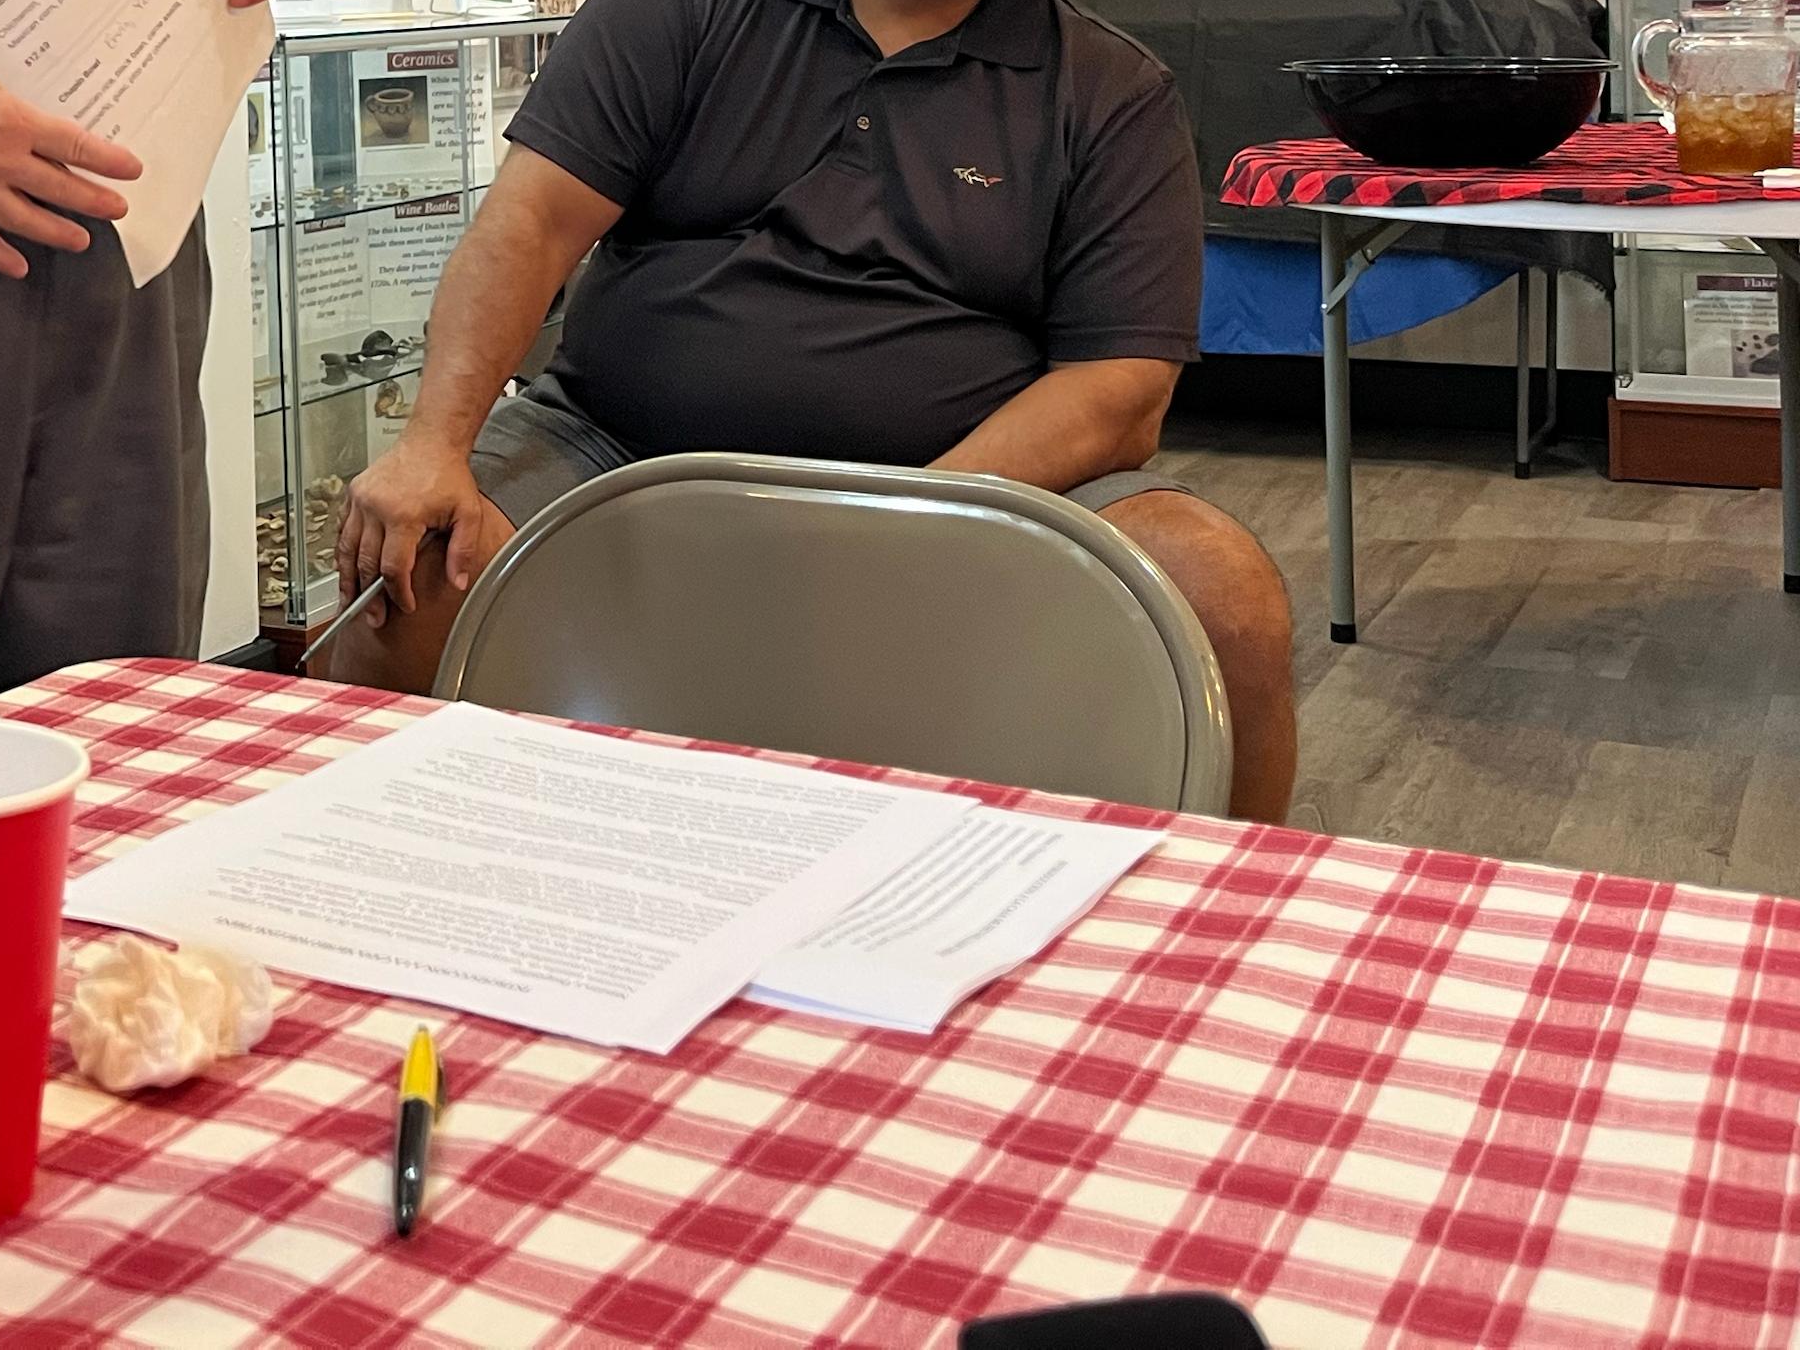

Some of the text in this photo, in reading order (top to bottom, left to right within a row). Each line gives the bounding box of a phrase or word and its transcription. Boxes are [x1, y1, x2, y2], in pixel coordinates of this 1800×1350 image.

[392, 53, 454, 68] Ceramics
[396, 200, 458, 215] Wine Bottles
